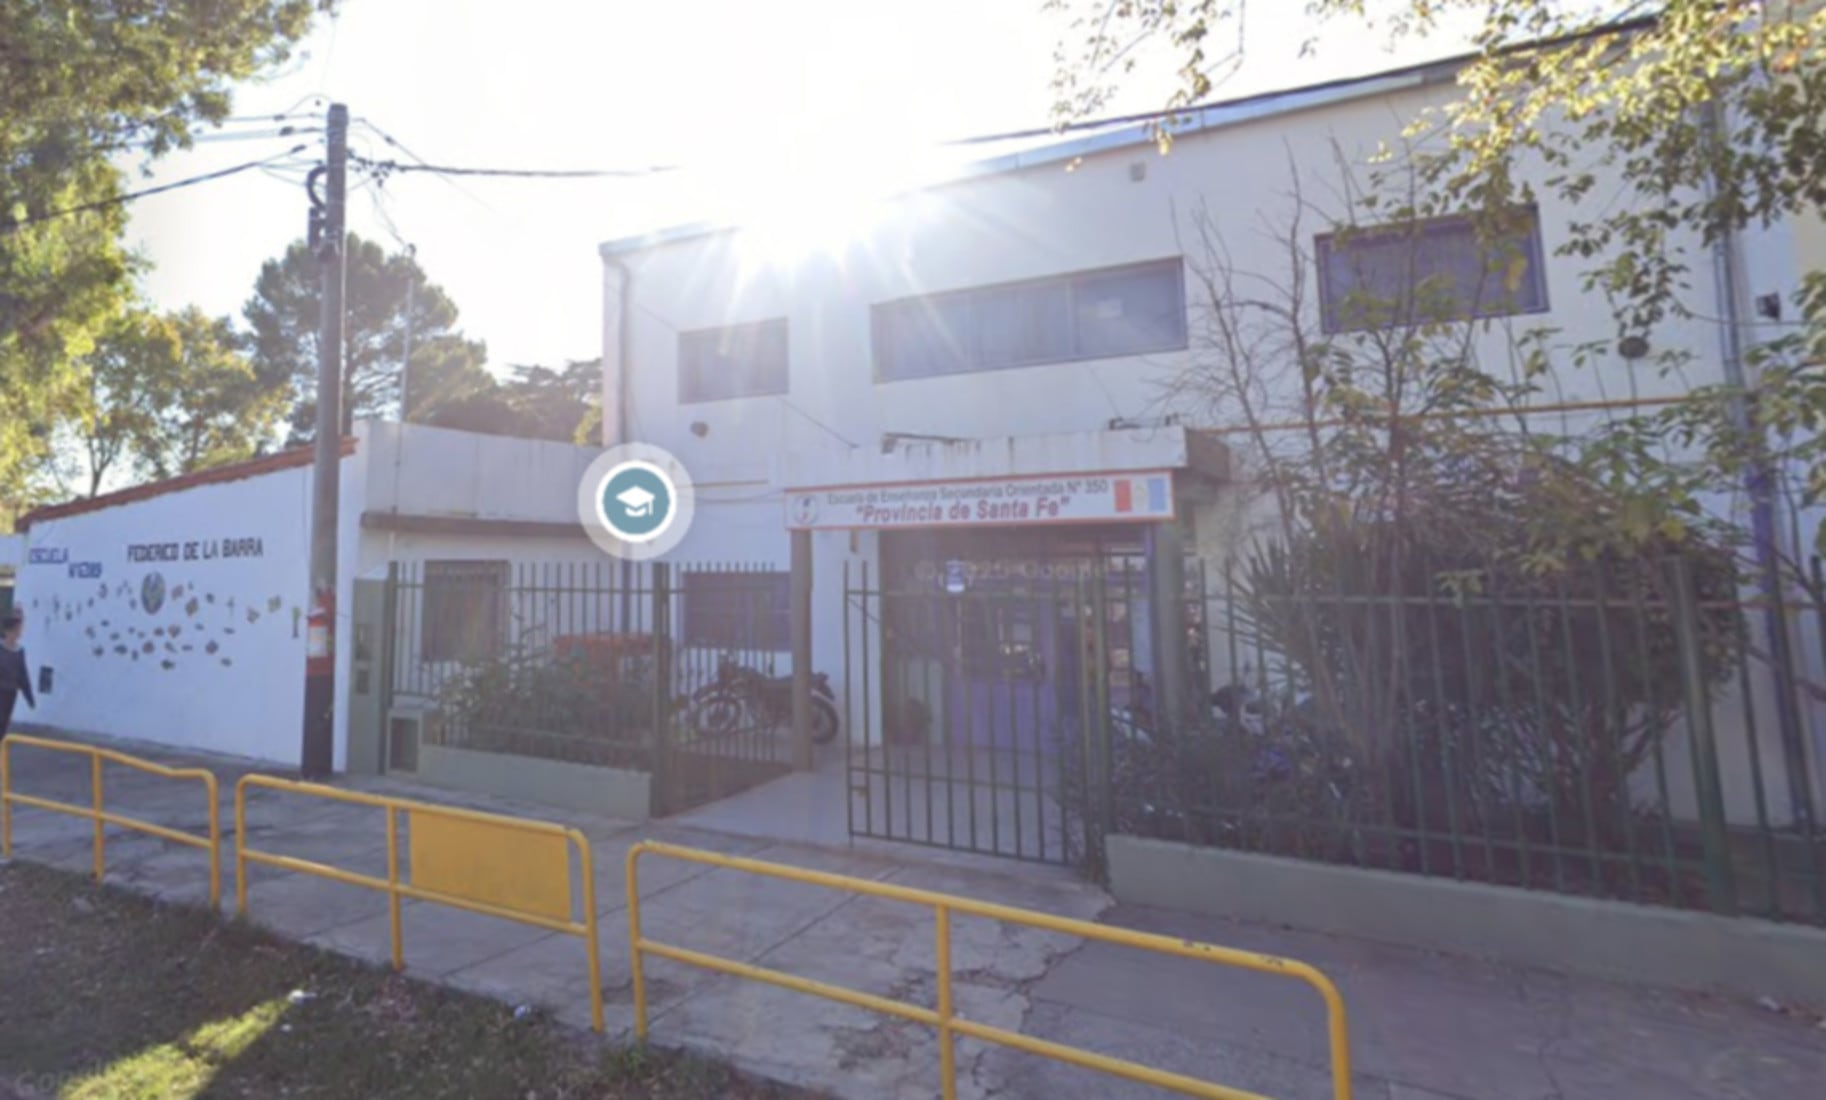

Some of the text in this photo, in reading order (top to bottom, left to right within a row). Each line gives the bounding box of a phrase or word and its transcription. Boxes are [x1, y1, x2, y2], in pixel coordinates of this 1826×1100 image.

[828, 493, 865, 506] Escuela
[867, 491, 878, 504] de
[941, 485, 1003, 500] Secundaria
[1006, 482, 1064, 497] Orientada
[856, 495, 1071, 522] "Provincia de Santa Fe"
[29, 547, 69, 564] ESCUELA
[127, 537, 264, 563] FEDERICO DE LA BARRA
